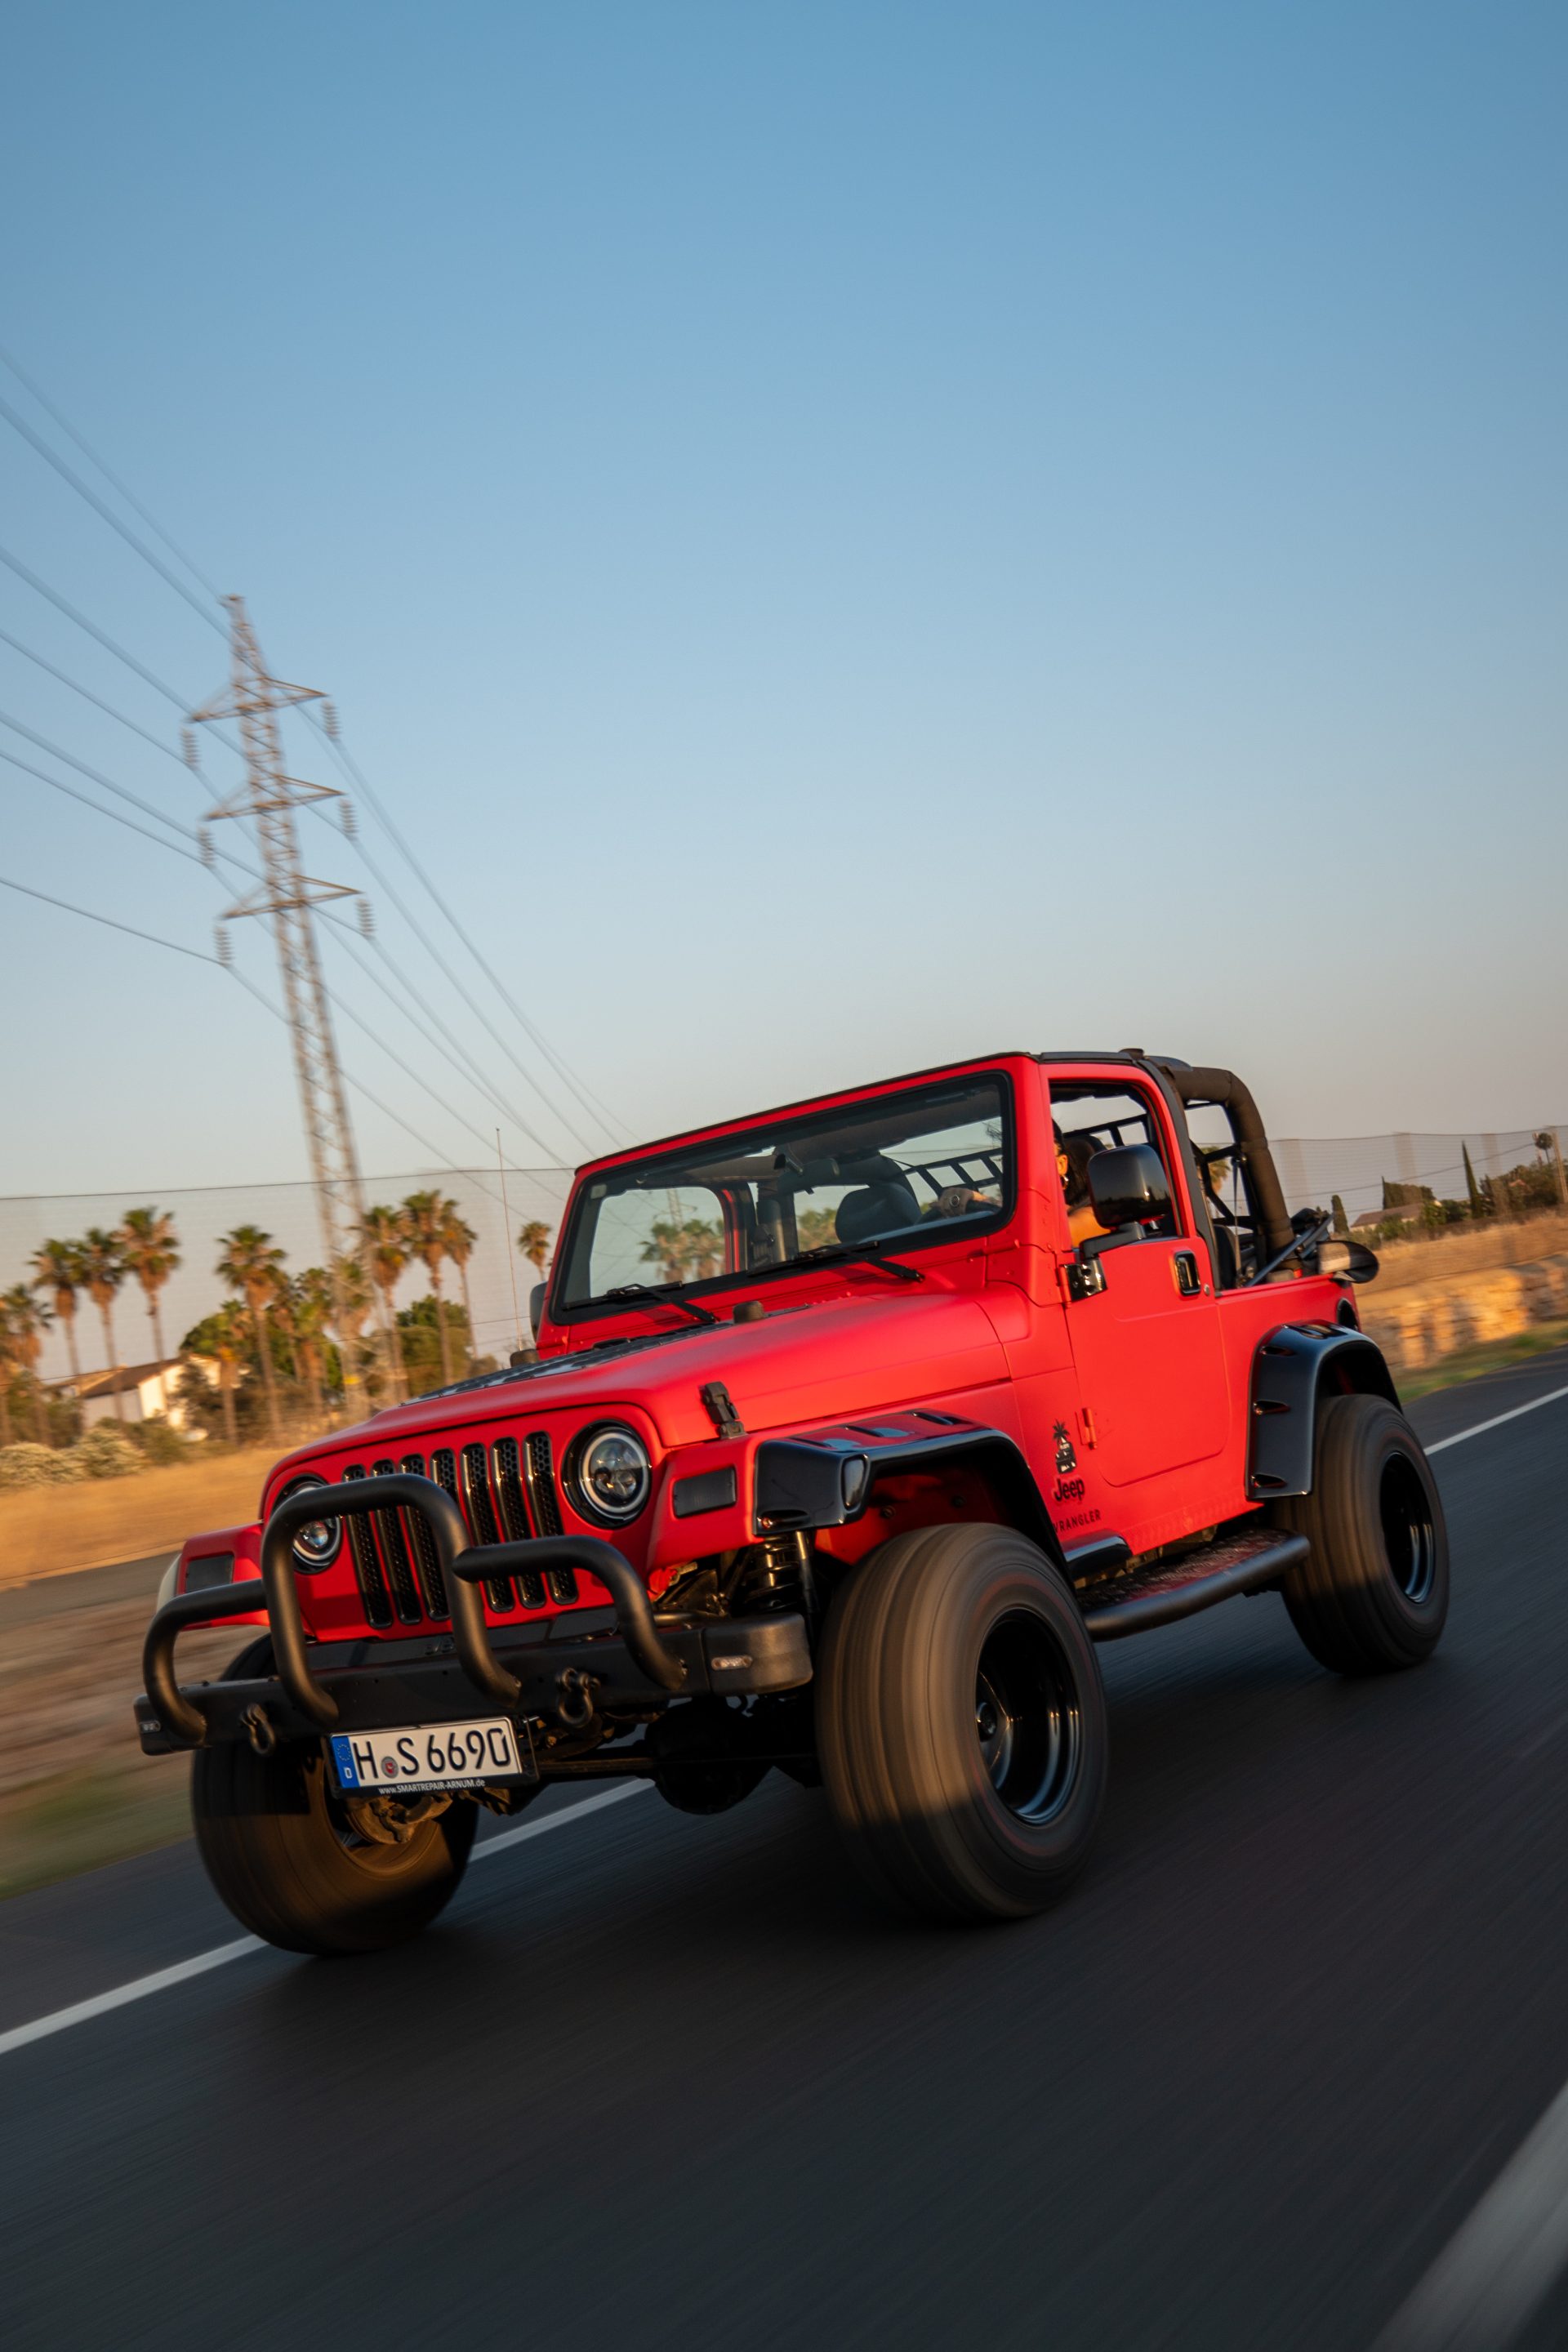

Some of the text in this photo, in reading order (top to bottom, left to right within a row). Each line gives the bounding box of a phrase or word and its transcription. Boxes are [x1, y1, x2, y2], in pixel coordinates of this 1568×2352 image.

[1054, 1478, 1085, 1502] Jeep
[353, 1741, 378, 1780] H
[378, 1779, 486, 1795] www.SMARTREPAIR-ARNUM.de
